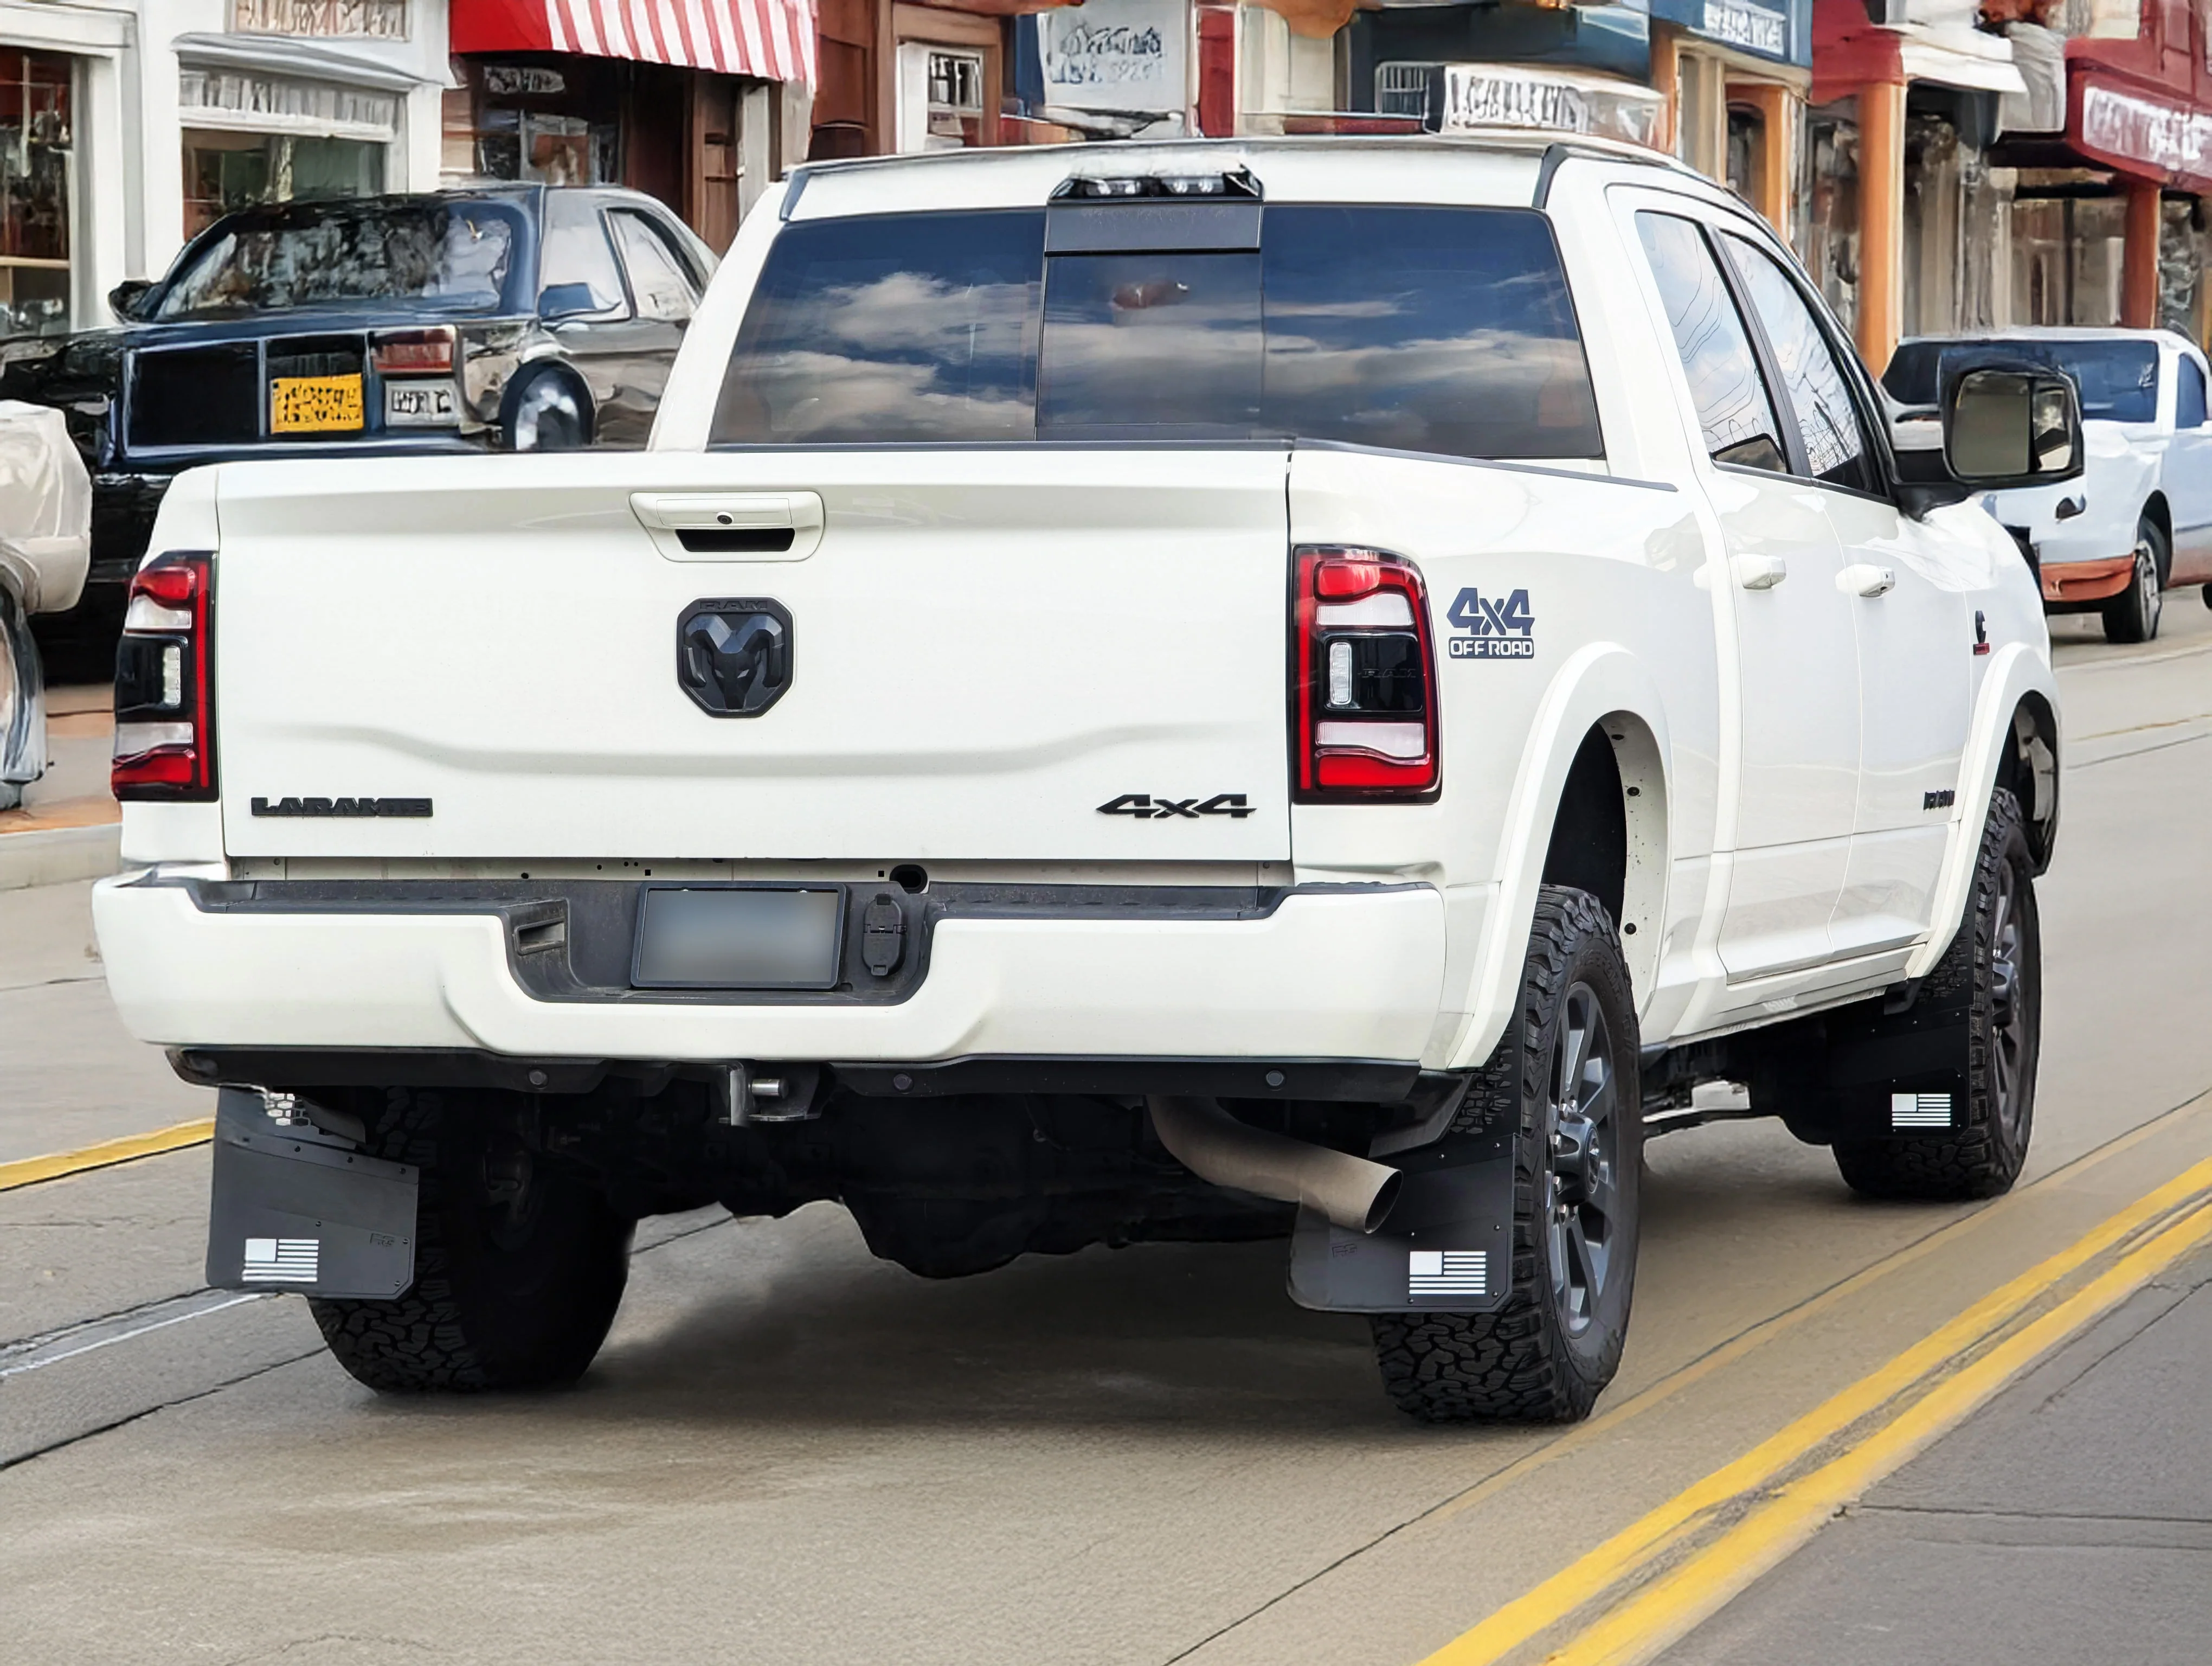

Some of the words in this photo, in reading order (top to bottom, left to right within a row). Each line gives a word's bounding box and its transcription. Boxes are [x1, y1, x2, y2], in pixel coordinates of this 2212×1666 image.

[699, 600, 768, 610] RAM
[1446, 587, 1535, 636] 4x4
[1450, 640, 1486, 655] OFF
[1488, 640, 1533, 656] ROAD
[1361, 668, 1417, 678] RAM
[1096, 794, 1257, 818] 4x4
